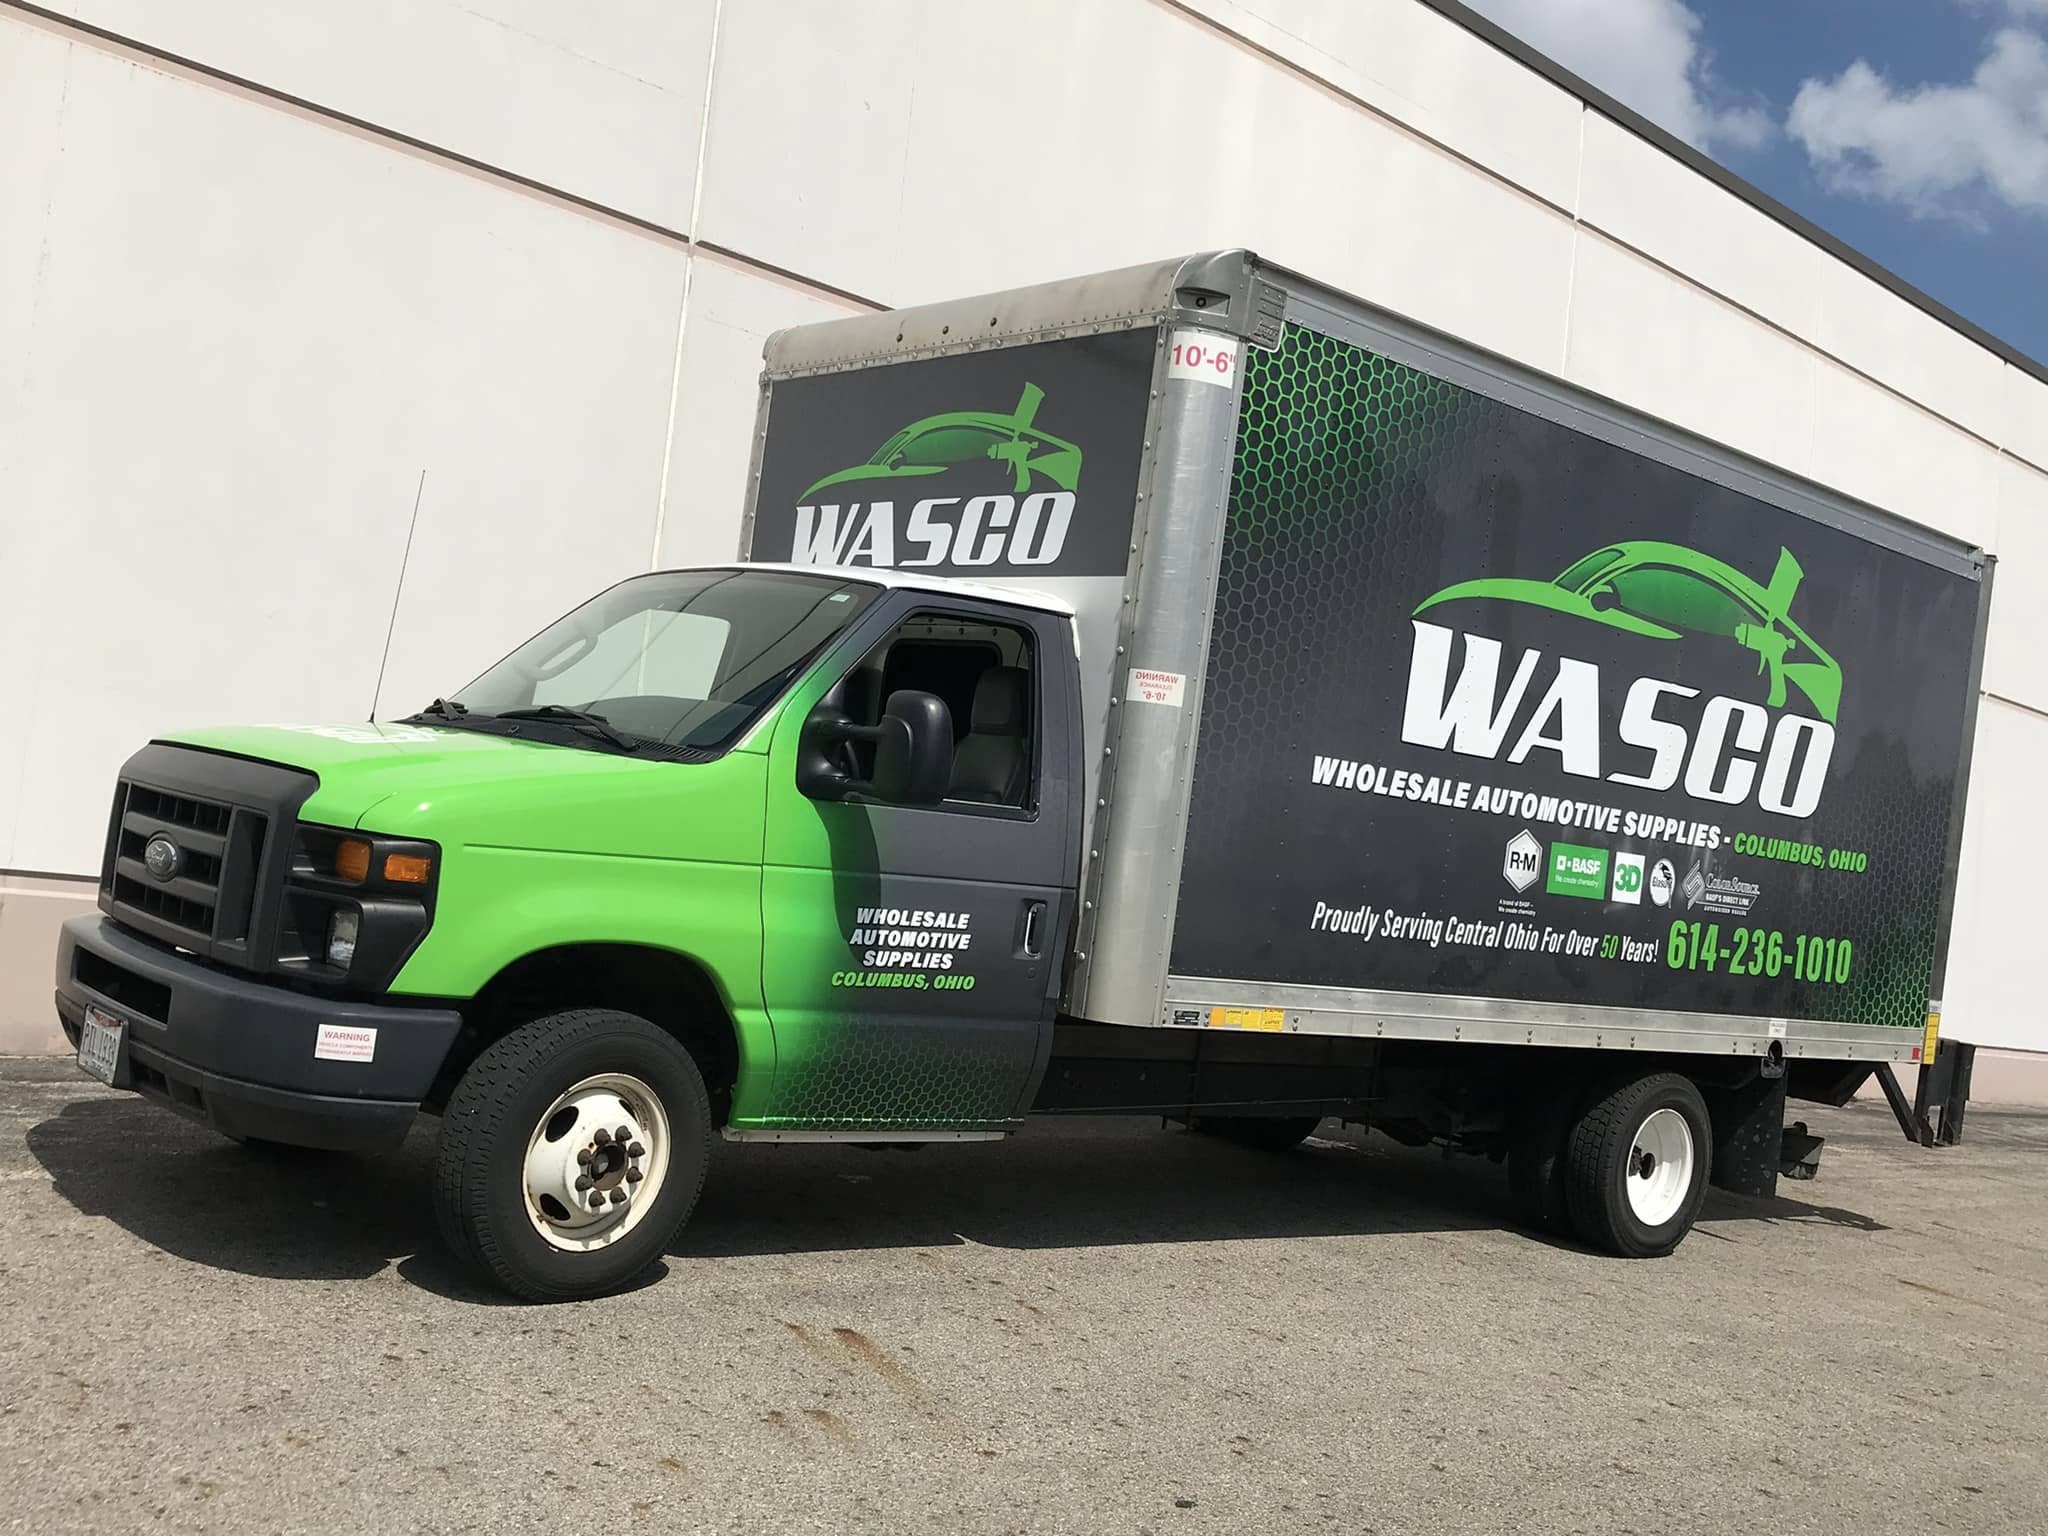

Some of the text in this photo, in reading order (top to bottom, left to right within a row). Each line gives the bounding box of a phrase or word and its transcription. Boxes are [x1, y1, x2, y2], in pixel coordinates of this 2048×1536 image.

[792, 491, 1076, 567] WASCO
[1400, 619, 1835, 818] WASCO
[1312, 755, 1471, 809] WHOLESALE
[1472, 785, 1622, 833] AUTOMOTIVE
[1623, 811, 1720, 849] SUPPLIES
[1734, 833, 1825, 869] COLUMBUS,
[1828, 849, 1867, 872] OHIO
[1572, 857, 1601, 875] BASF
[1615, 863, 1641, 892] 3D
[856, 908, 970, 929] WHOLESALE
[850, 929, 972, 949] AUTOMOTIVE
[1311, 901, 1660, 963] Proudly Serving Central Ohio For Over 50 Years!
[863, 950, 953, 969] SUPPLIES
[1667, 920, 1852, 984] 614-236-1010
[831, 971, 975, 990] COLUMBUS, OHIO
[324, 1031, 370, 1042] WARNING
